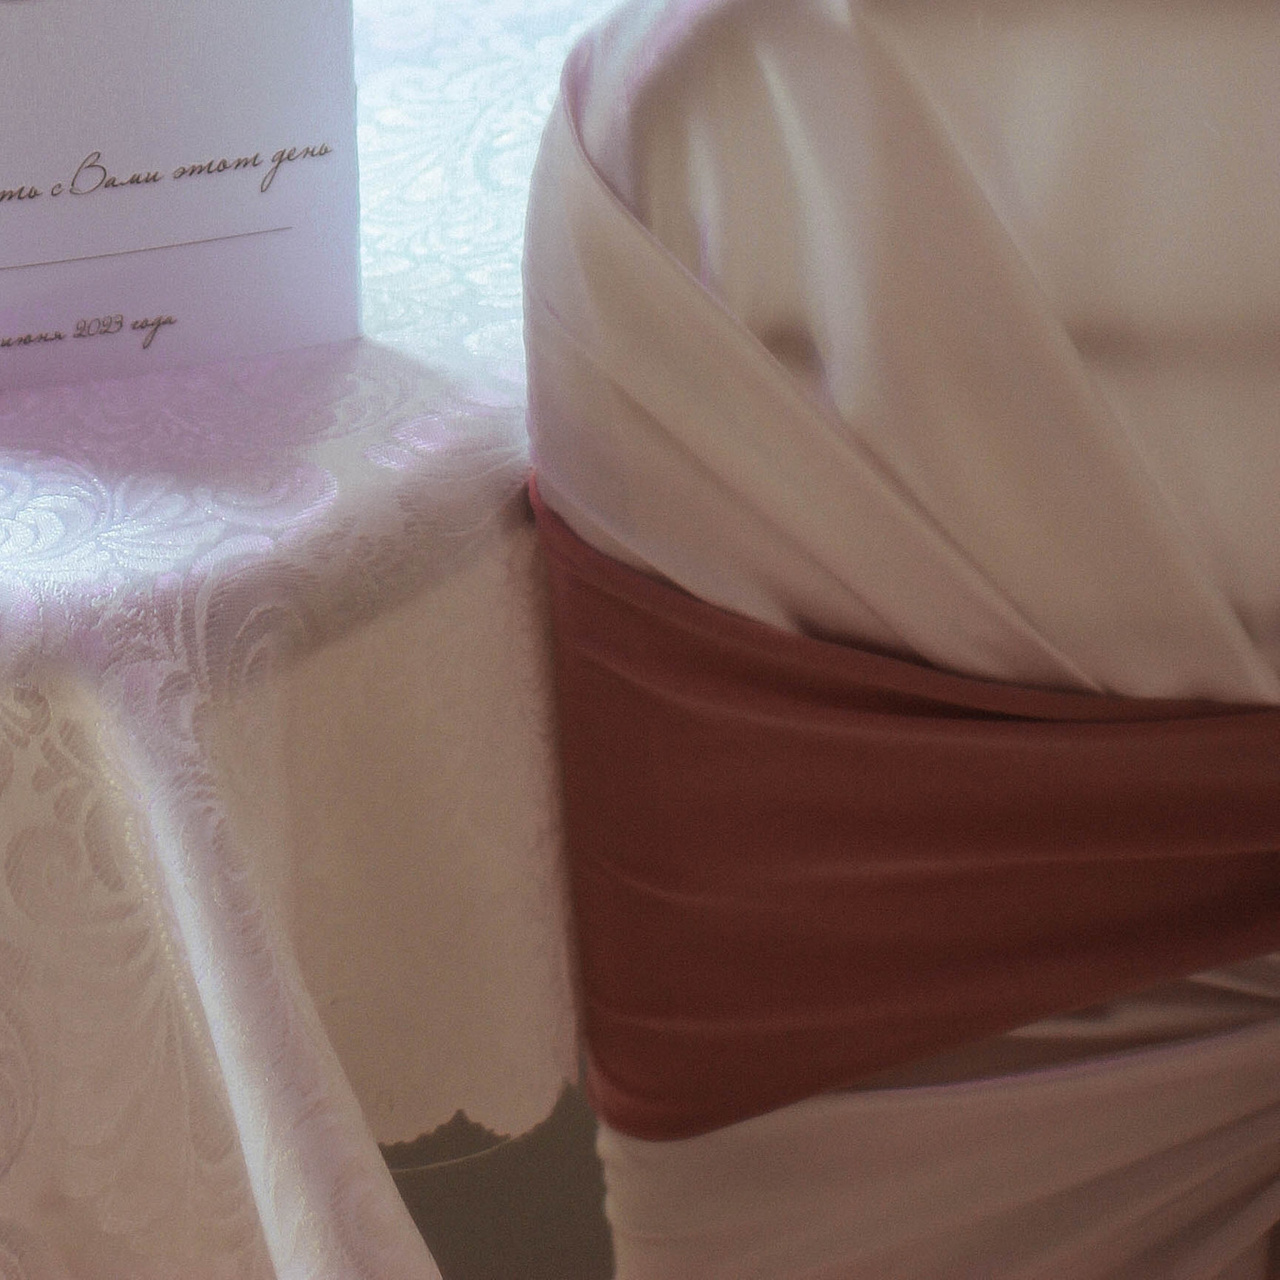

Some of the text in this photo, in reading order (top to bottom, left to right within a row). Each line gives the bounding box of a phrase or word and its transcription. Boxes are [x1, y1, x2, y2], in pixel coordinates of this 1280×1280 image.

[51, 182, 63, 197] с
[70, 151, 163, 195] Вами
[172, 151, 263, 180] этот
[260, 142, 332, 193] день
[73, 314, 124, 339] 2023
[131, 315, 177, 350] года
